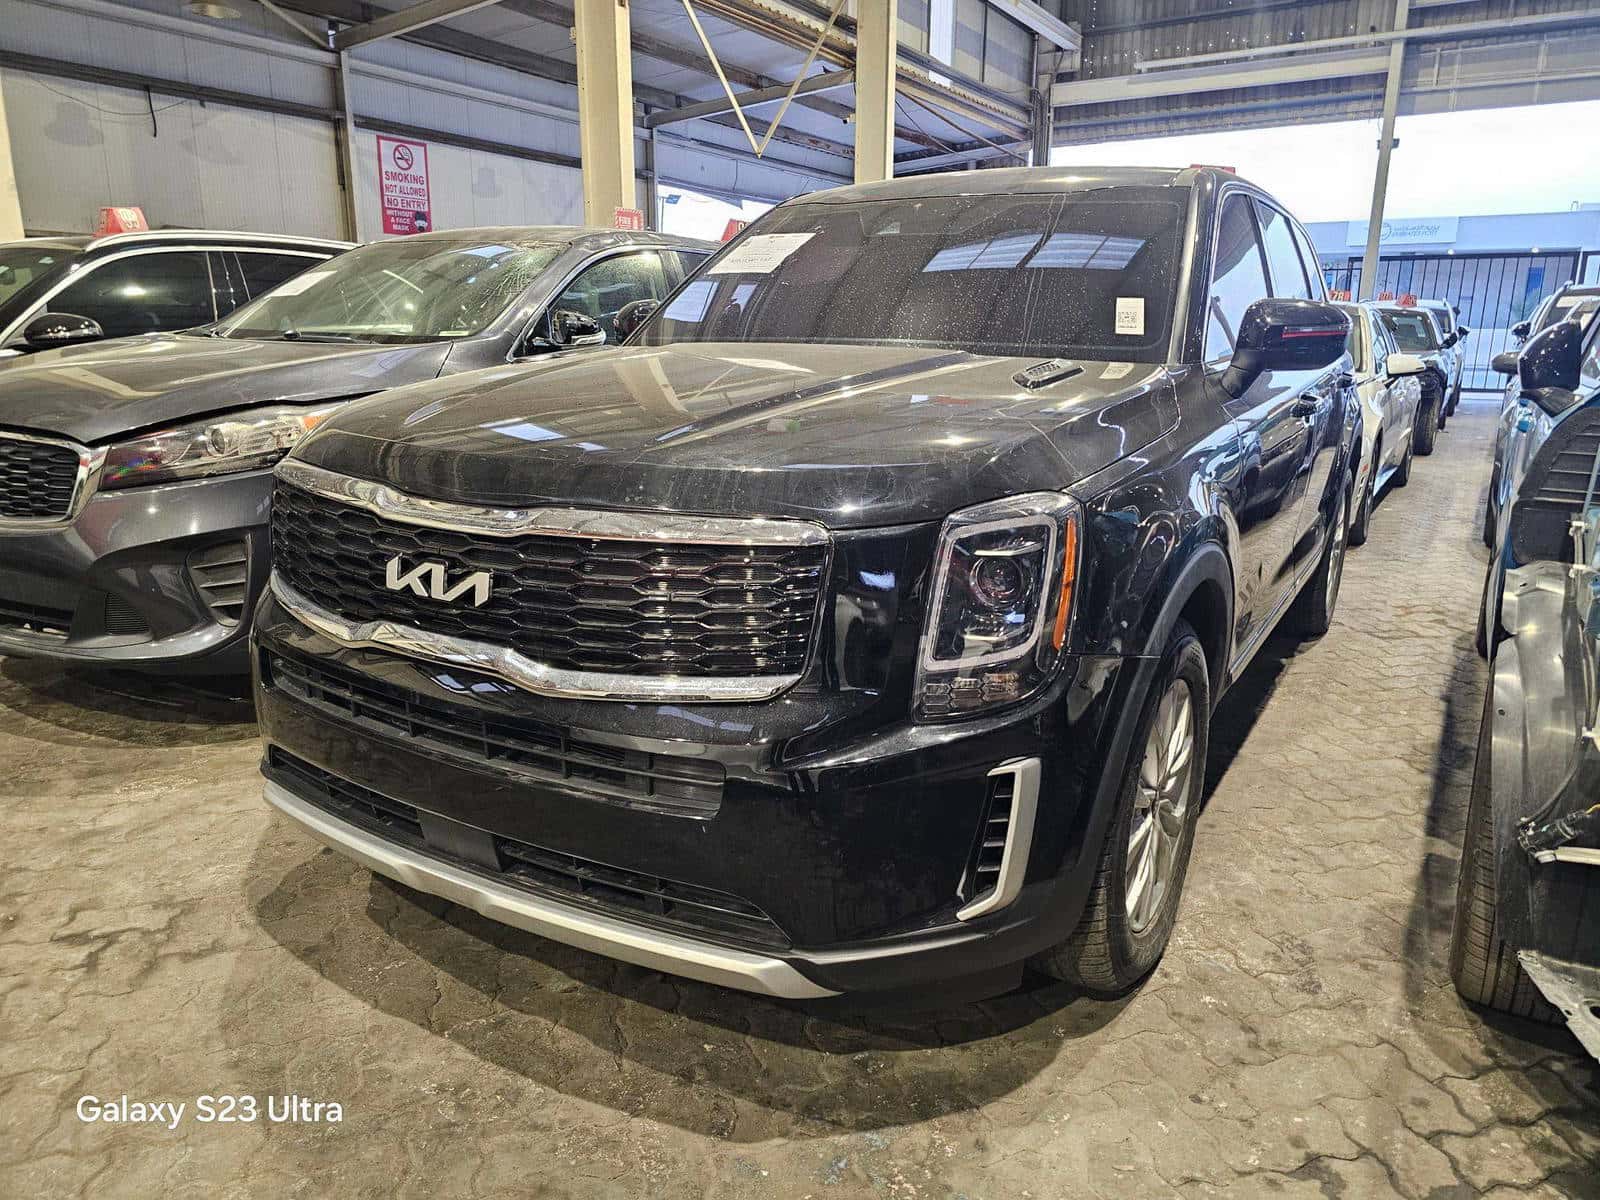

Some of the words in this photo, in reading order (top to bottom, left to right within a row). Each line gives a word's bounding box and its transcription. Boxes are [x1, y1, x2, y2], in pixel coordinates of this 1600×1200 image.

[384, 171, 425, 185] SMOKING
[385, 183, 397, 194] NOT
[399, 186, 426, 198] ALLOWED
[386, 197, 399, 208] NO
[401, 199, 426, 210] ENTRY
[386, 553, 490, 609] KIA
